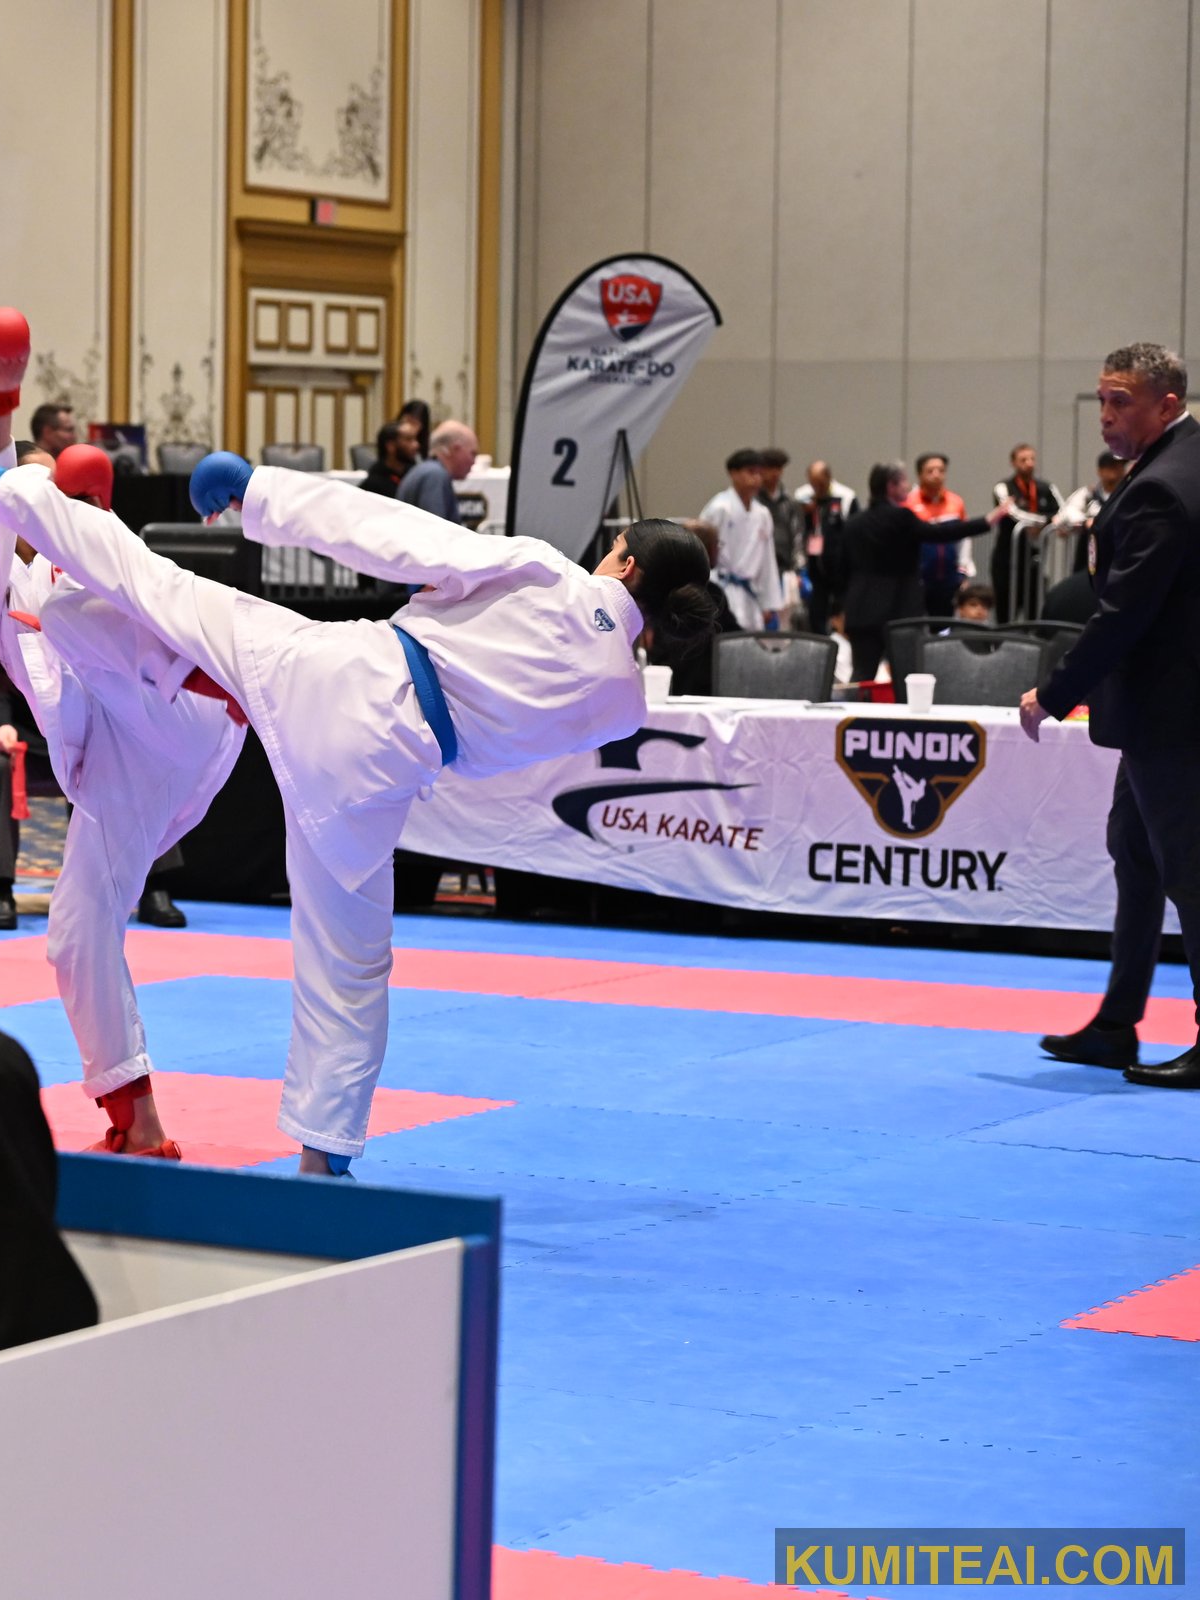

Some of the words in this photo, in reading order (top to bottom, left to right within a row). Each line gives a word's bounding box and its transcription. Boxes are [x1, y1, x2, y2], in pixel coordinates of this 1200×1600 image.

[607, 283, 653, 304] USA
[566, 355, 675, 378] KARATE-DO
[551, 437, 578, 487] 2
[844, 729, 976, 763] PUNOK
[601, 804, 648, 834] USA
[655, 813, 764, 851] KARATE
